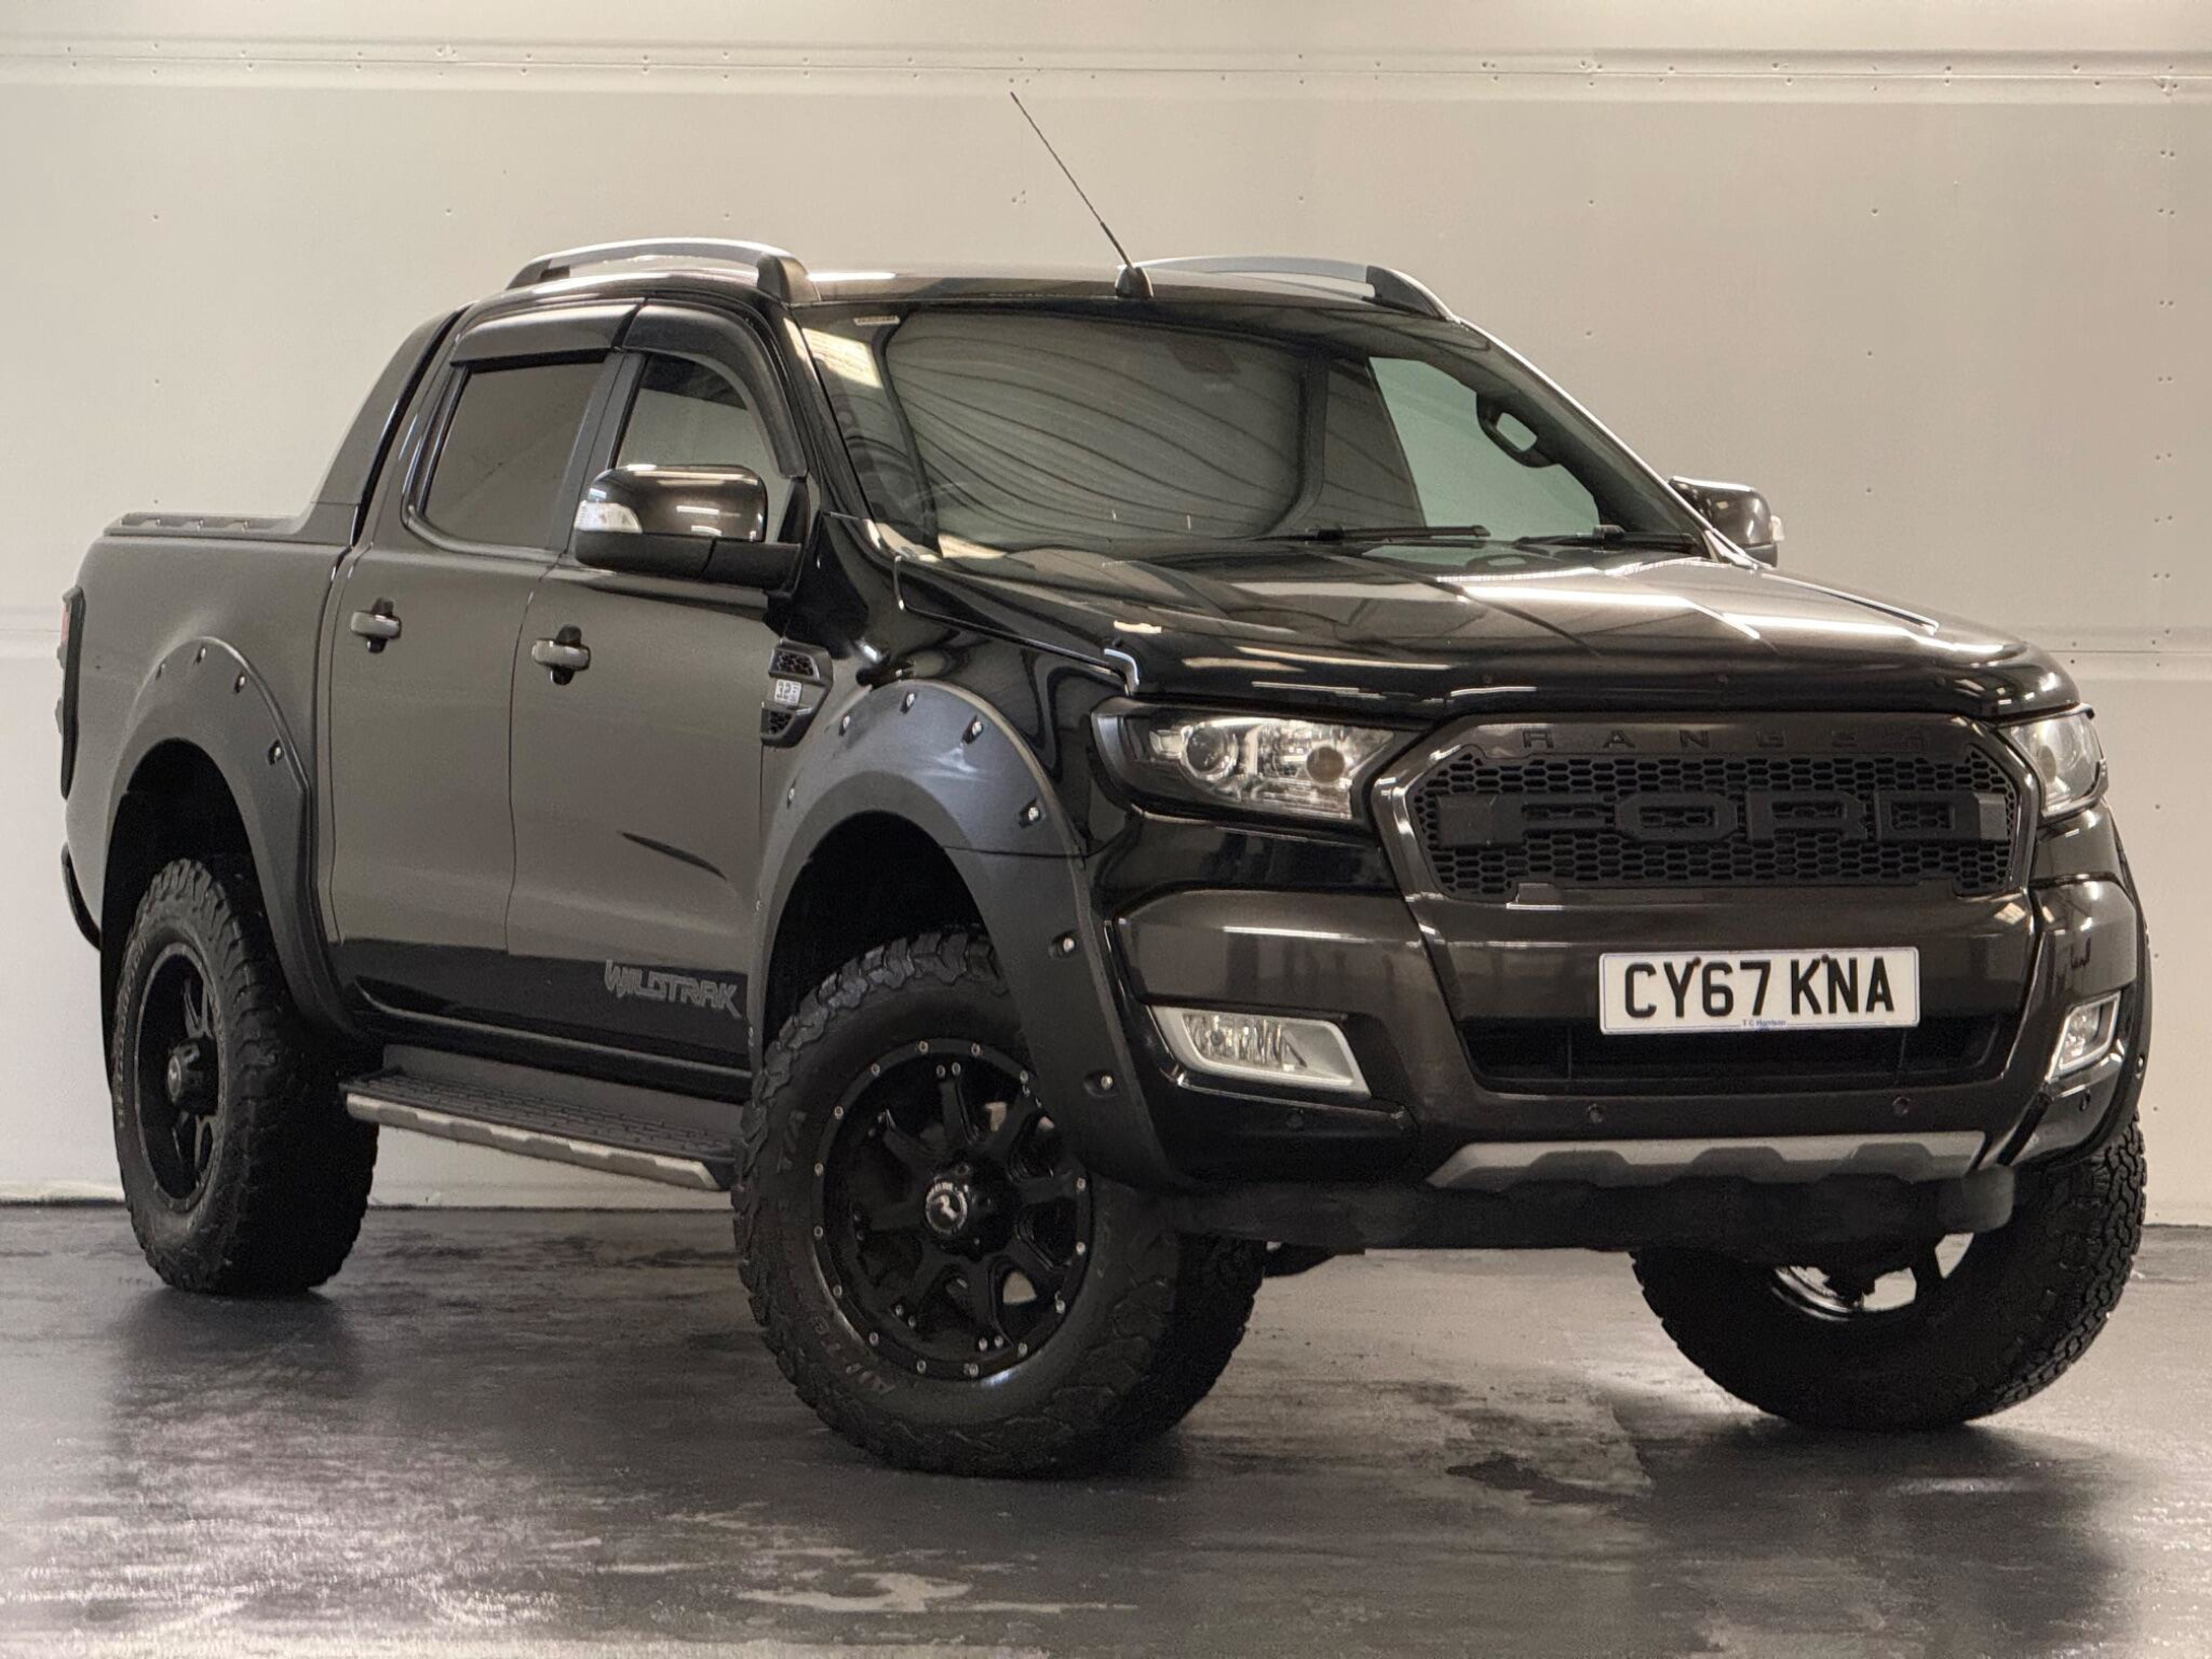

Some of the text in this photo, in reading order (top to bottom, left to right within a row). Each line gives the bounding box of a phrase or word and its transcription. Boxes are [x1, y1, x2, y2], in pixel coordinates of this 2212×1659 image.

[1436, 789, 2008, 846] FORD
[605, 959, 742, 1019] WILDTRAK
[1624, 957, 1895, 1018] CY67 KNA
